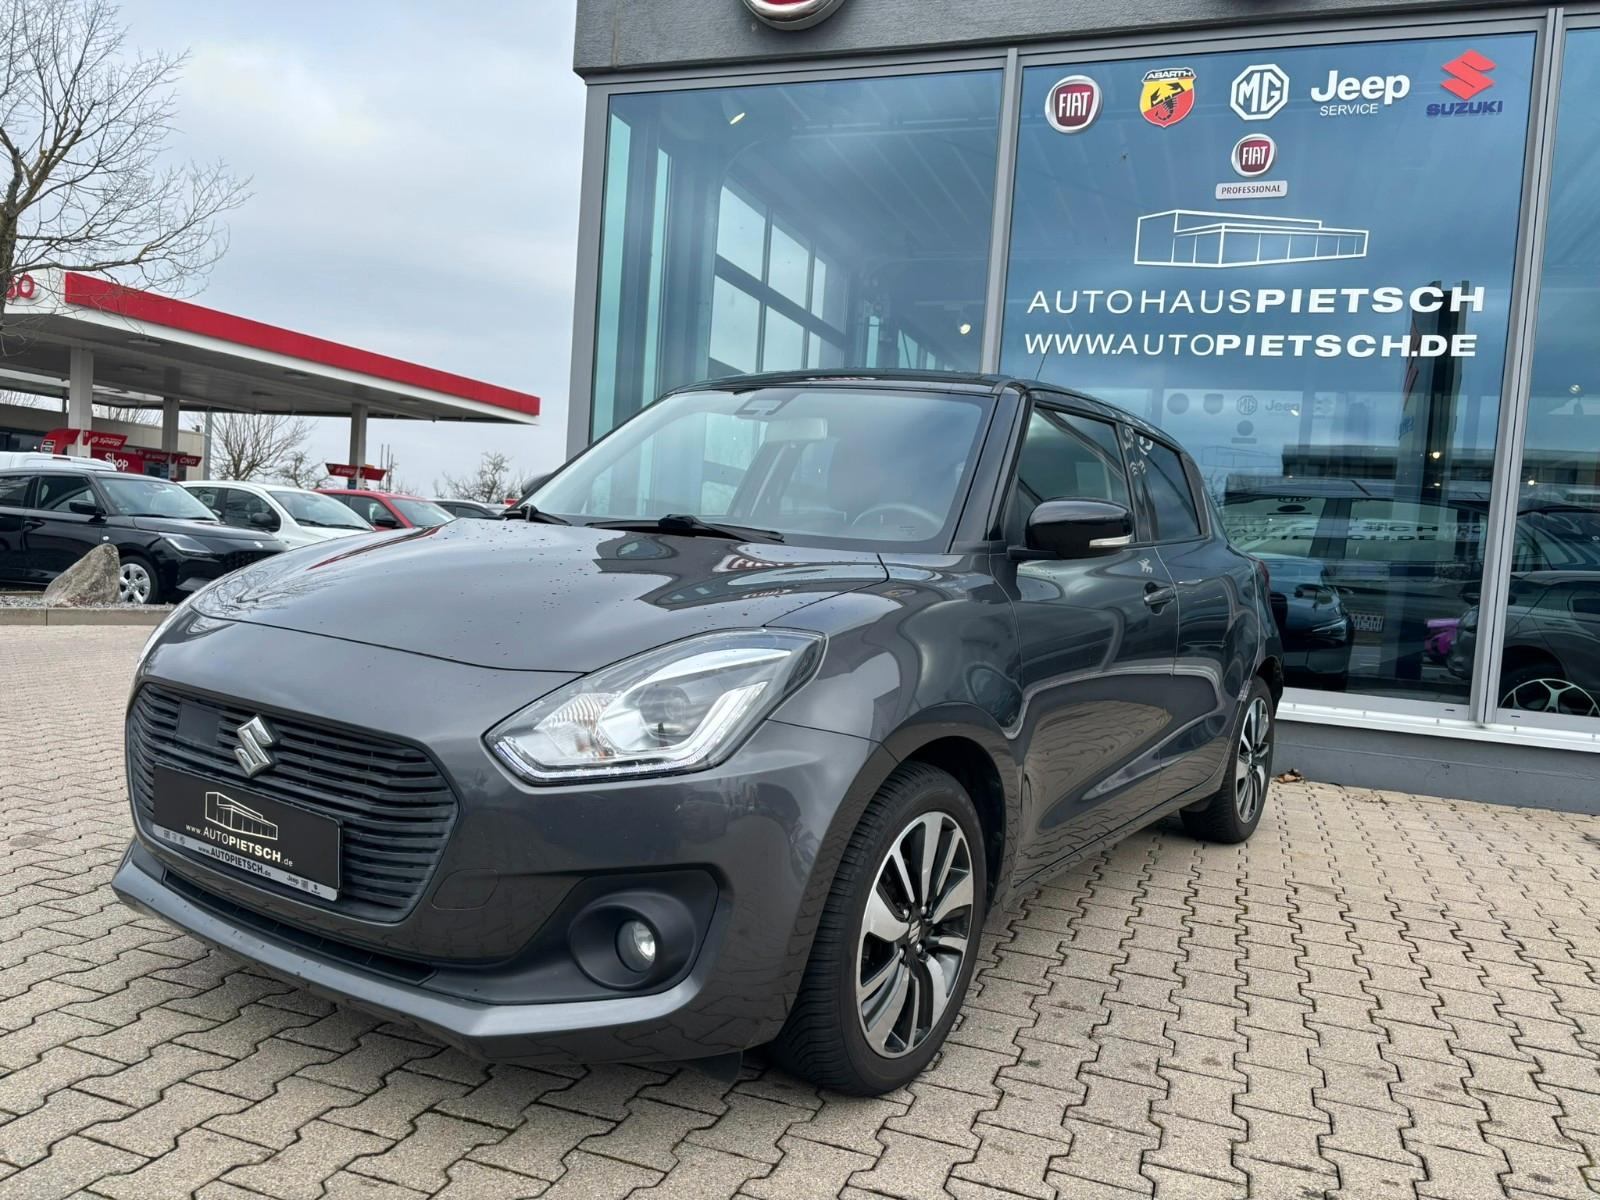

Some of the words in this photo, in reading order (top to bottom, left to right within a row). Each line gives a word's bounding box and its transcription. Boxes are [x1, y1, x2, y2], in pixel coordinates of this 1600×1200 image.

[1146, 70, 1192, 80] ABARTH
[1237, 71, 1283, 114] MG
[1310, 69, 1411, 105] Jeep
[1057, 91, 1091, 118] FIAT
[1319, 103, 1379, 116] SERVICE
[1426, 100, 1503, 117] SUZUKI
[1241, 145, 1268, 166] FIAT
[1221, 184, 1281, 195] PROFESSIONAL
[1027, 286, 1485, 314] AUTOHAUSPIETSCH
[1024, 333, 1478, 358] WWW.AUTOPIETSCH.DE
[104, 452, 129, 471] Shop
[185, 824, 293, 867] www.AUTOPIETSCH.de
